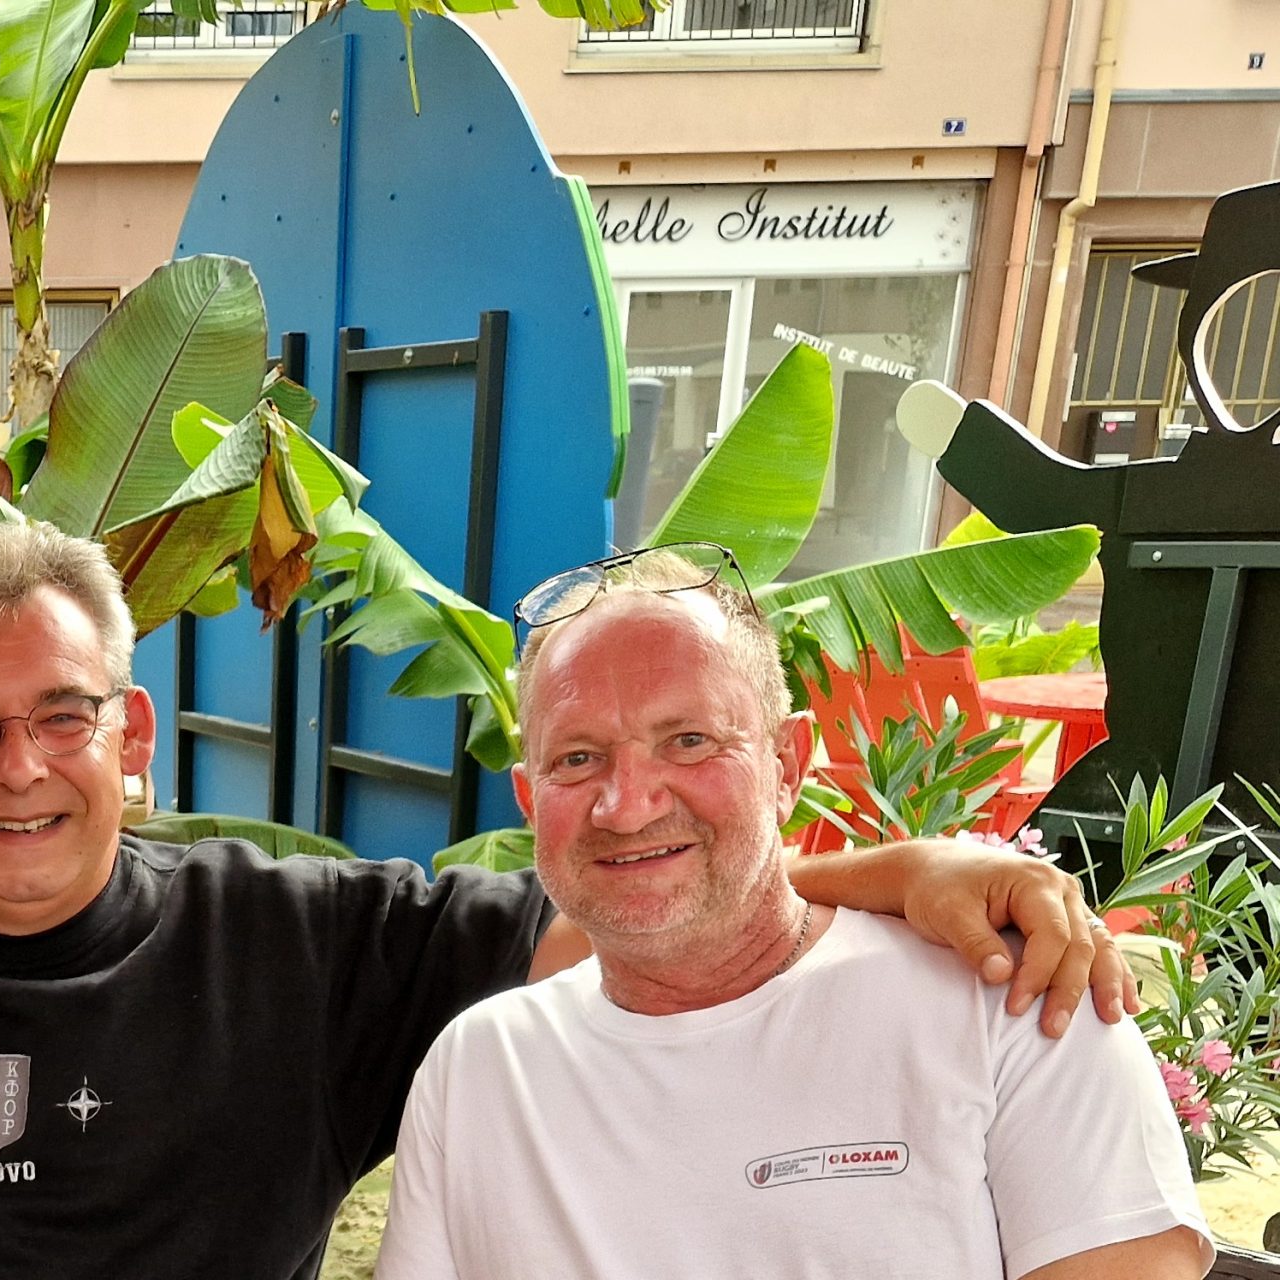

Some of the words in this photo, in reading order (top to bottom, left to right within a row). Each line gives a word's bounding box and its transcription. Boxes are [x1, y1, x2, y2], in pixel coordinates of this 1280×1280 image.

[717, 187, 895, 242] Institut
[838, 346, 859, 364] DE
[861, 353, 916, 380] BEAUTE
[2, 1061, 20, 1135] КФОР
[841, 1150, 899, 1163] LOXAM
